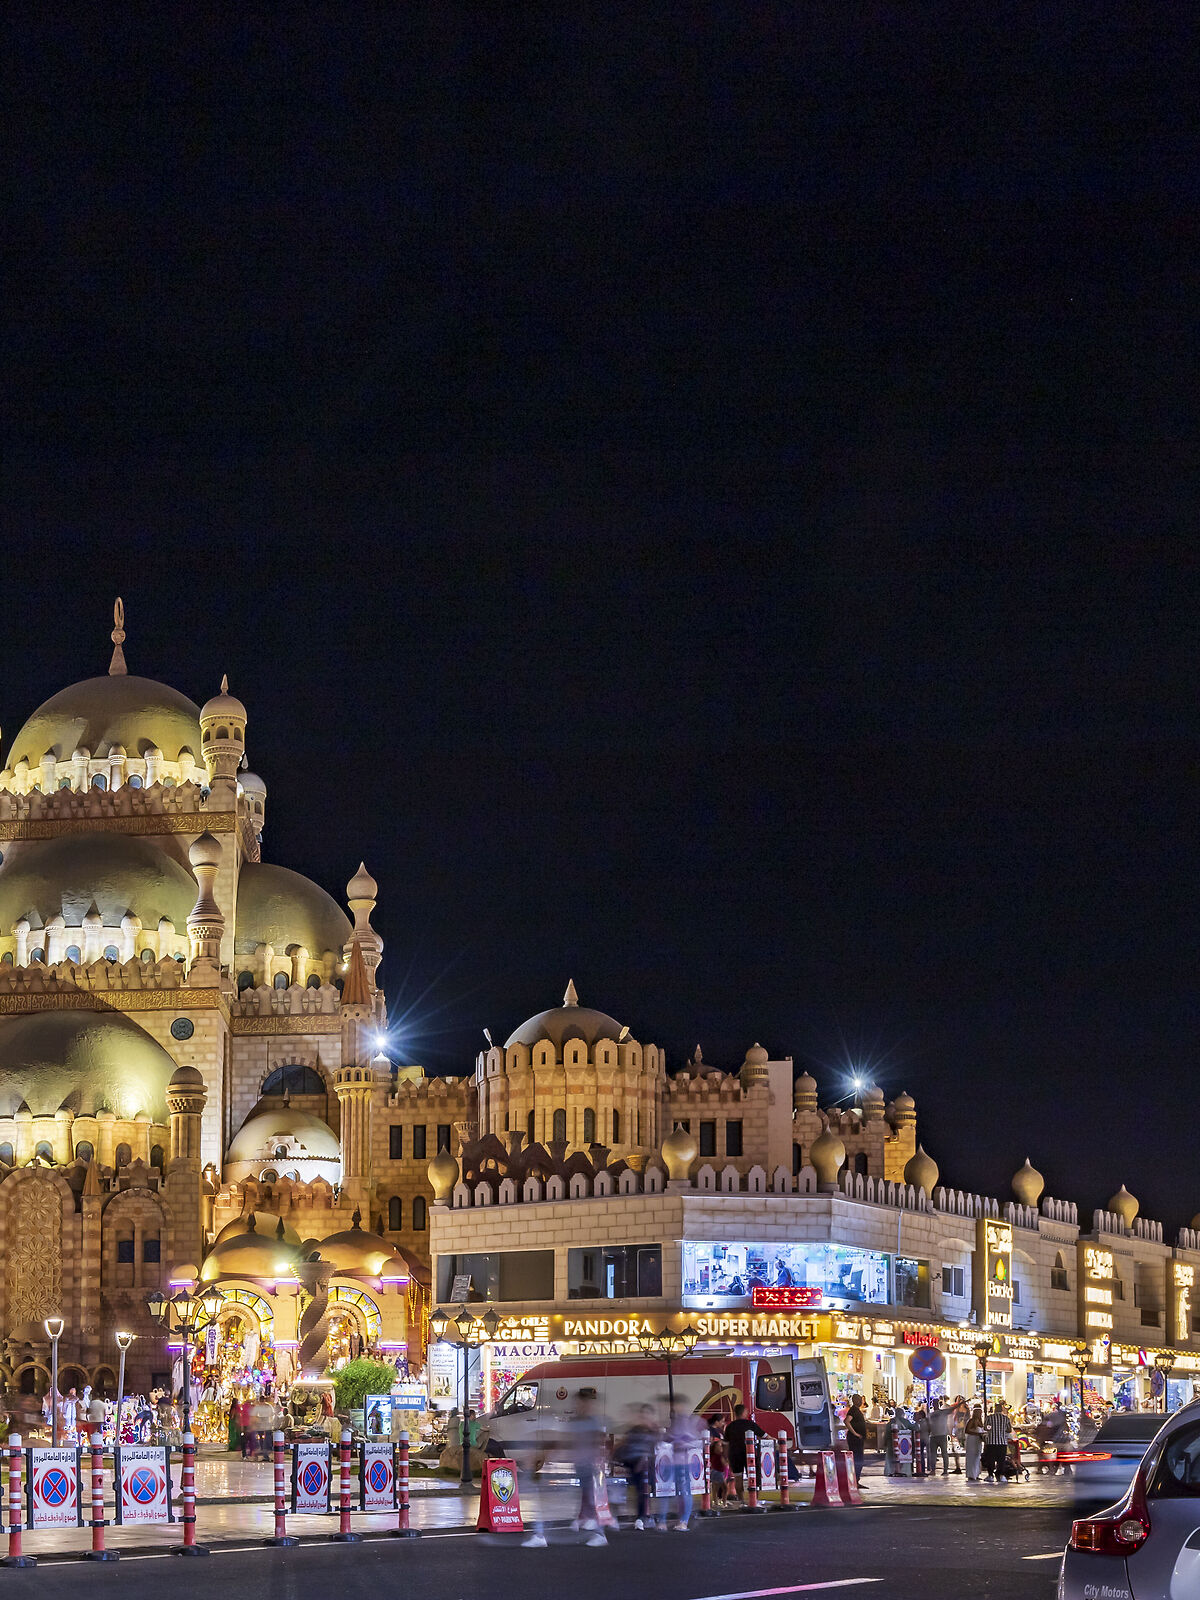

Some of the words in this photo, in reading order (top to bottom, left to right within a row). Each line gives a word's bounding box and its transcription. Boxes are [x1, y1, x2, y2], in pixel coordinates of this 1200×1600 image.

[520, 1317, 549, 1326] OILS
[564, 1320, 654, 1335] PANDORA
[697, 1319, 749, 1336] SUPER
[752, 1320, 820, 1337] MARKET
[579, 1343, 641, 1354] PANDO
[1009, 1348, 1034, 1359] SWEETS
[1084, 1584, 1099, 1599] City
[1101, 1585, 1129, 1599] Motors
